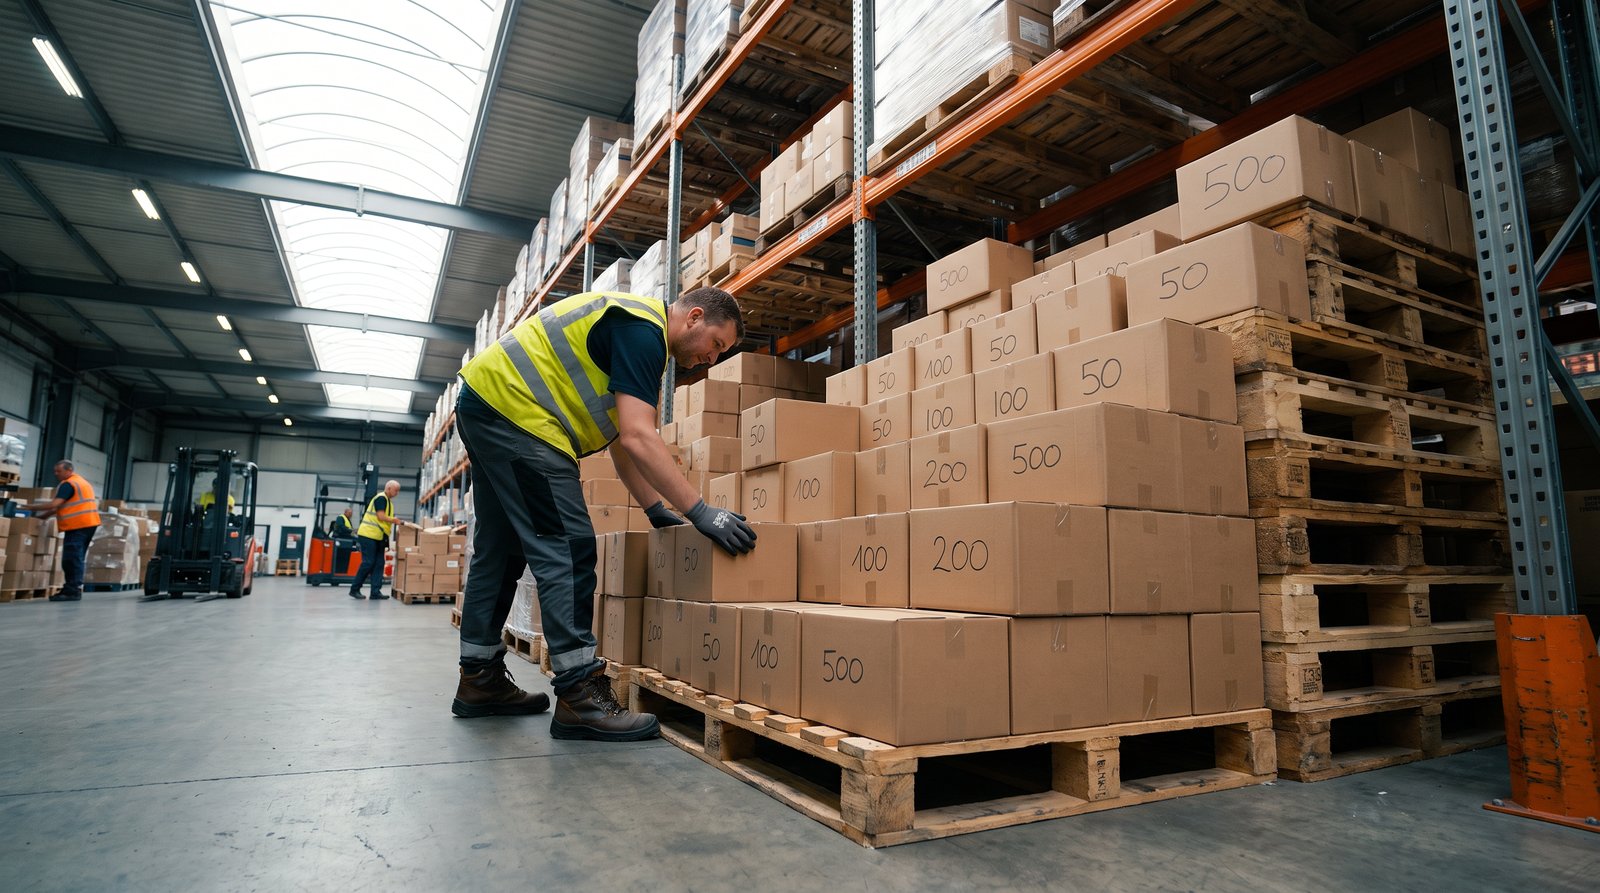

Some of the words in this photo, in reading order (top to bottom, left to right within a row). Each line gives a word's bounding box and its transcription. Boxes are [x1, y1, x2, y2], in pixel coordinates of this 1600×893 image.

[1203, 154, 1286, 211] 500
[939, 264, 969, 292] 500
[1159, 262, 1209, 300] 50
[990, 334, 1017, 362] 50
[924, 355, 953, 381] 100
[1081, 358, 1122, 396] 50
[878, 371, 896, 394] 50
[994, 386, 1029, 418] 100
[872, 418, 892, 442] 50
[926, 406, 954, 432] 100
[750, 424, 765, 447] 50
[1012, 443, 1062, 475] 500
[923, 459, 968, 488] 200
[752, 487, 768, 511] 50
[793, 477, 821, 502] 100
[684, 546, 699, 573] 50
[851, 545, 888, 573] 100
[932, 535, 989, 573] 200
[701, 632, 721, 663] 50
[750, 639, 779, 669] 100
[822, 650, 864, 684] 500
